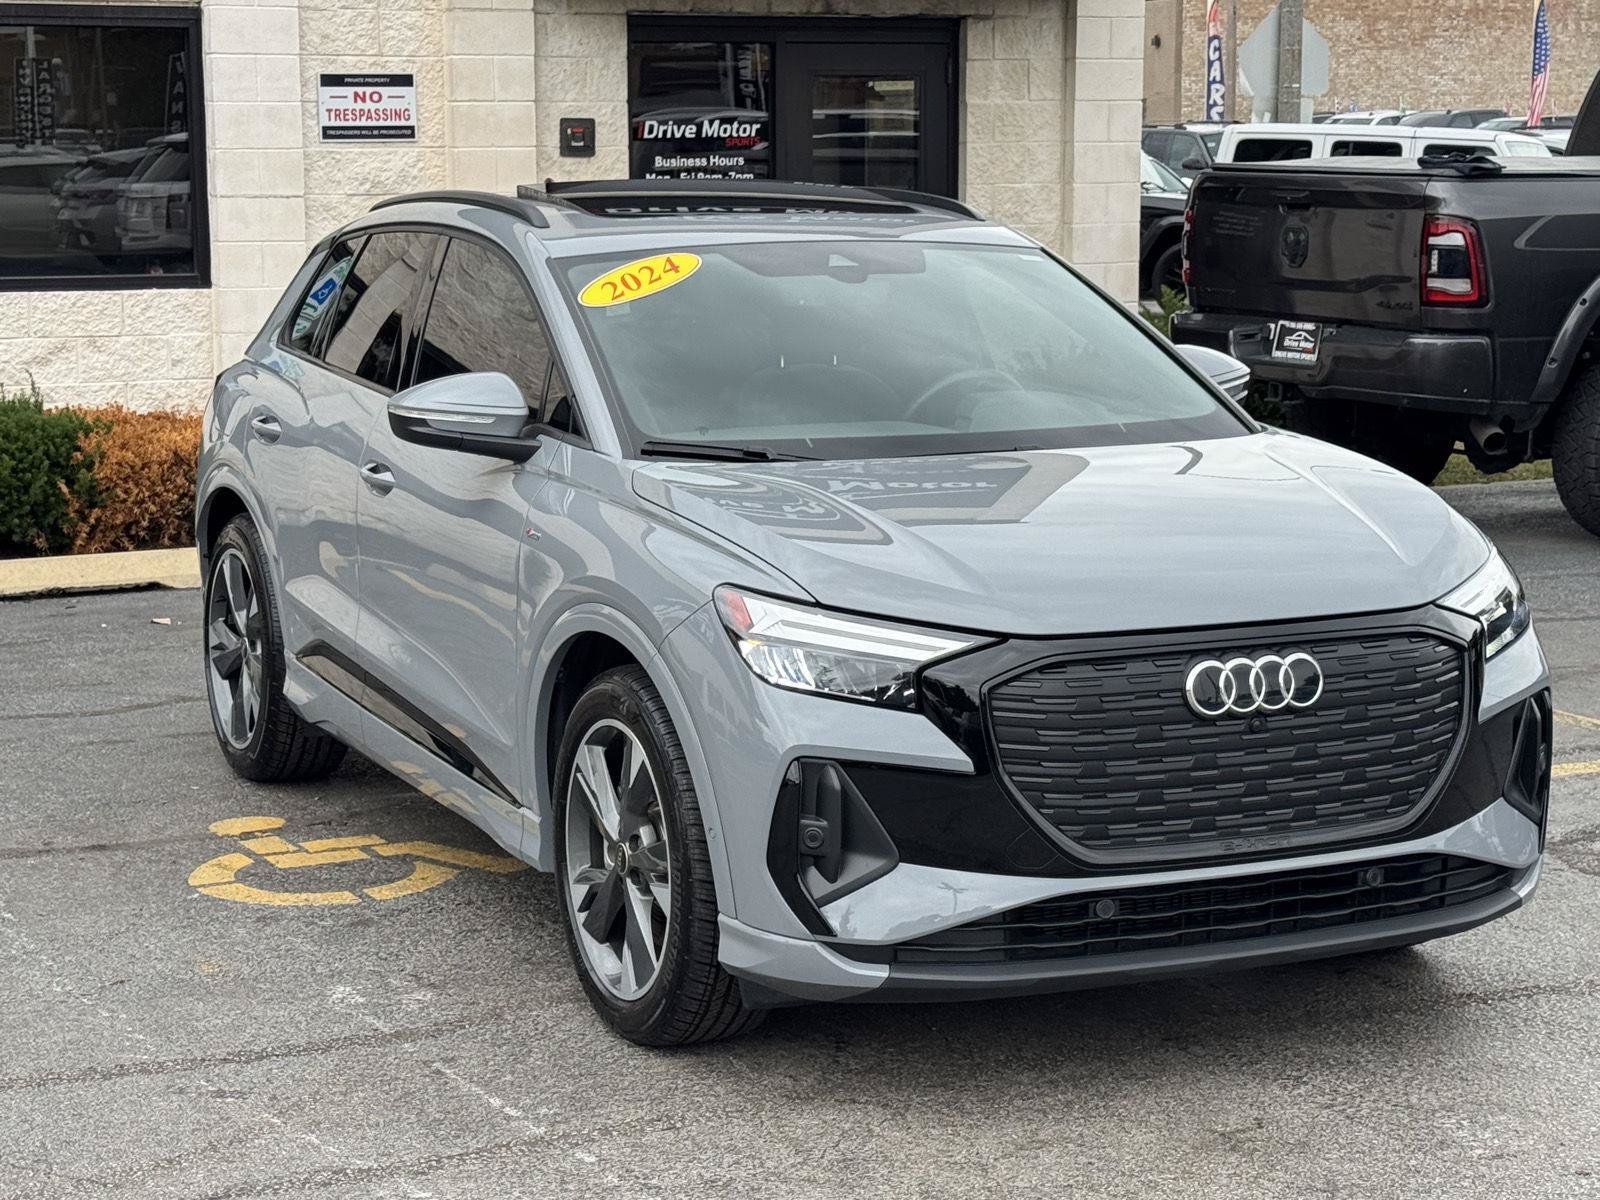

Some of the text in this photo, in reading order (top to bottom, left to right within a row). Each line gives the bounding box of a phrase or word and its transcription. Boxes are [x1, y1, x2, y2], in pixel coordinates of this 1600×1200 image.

[353, 90, 383, 104] NO
[325, 107, 411, 122] TRESPASSING
[701, 120, 761, 138] Motor
[725, 137, 760, 147] SPORTS
[654, 155, 745, 168] Business Hours
[600, 256, 681, 301] 2024
